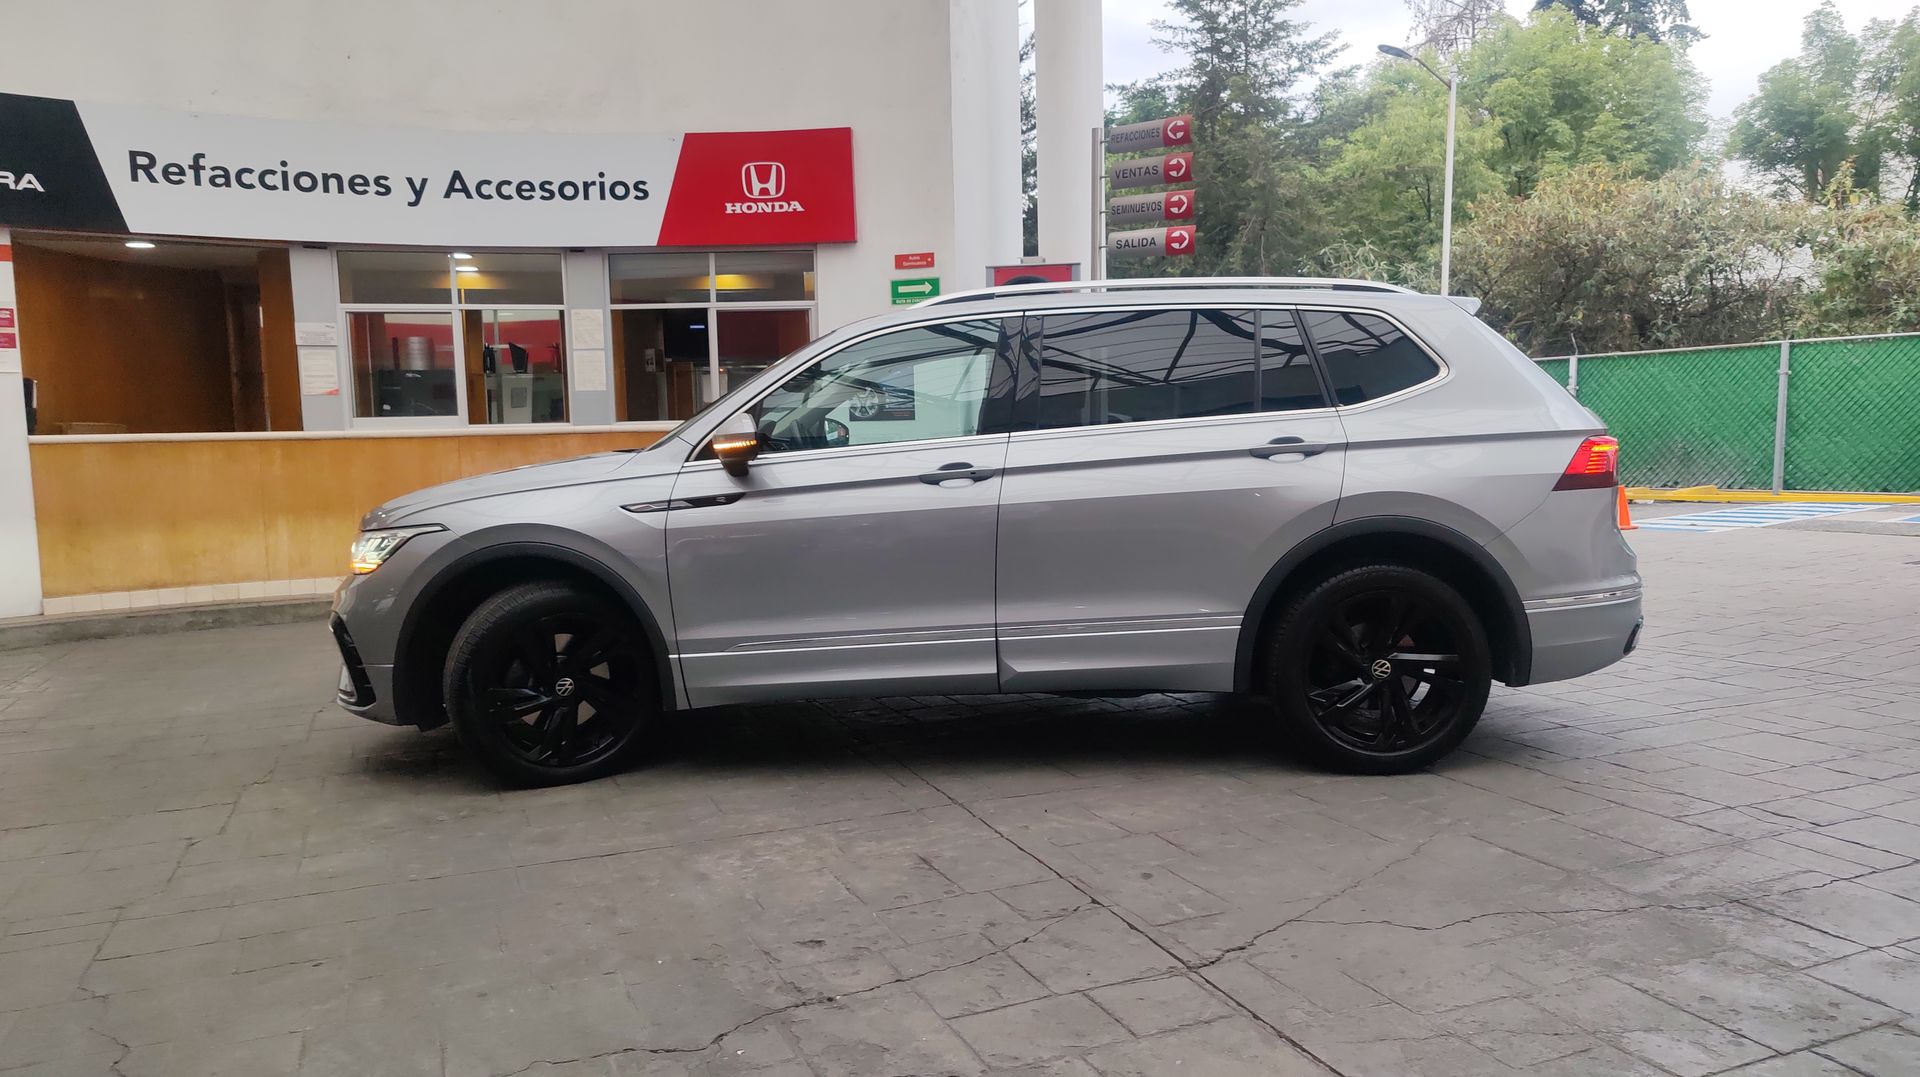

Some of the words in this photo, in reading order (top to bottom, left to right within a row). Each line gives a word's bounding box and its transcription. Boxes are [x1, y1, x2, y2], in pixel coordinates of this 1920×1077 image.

[1111, 128, 1160, 144] REFACCIONES
[128, 150, 392, 196] Refacciones
[405, 177, 428, 207] y
[443, 170, 650, 201] Accesorios
[1115, 165, 1159, 179] VENTAS
[725, 201, 804, 213] HONDA
[1111, 201, 1162, 215] SEMINUEVOS
[1115, 237, 1157, 249] SALIDA
